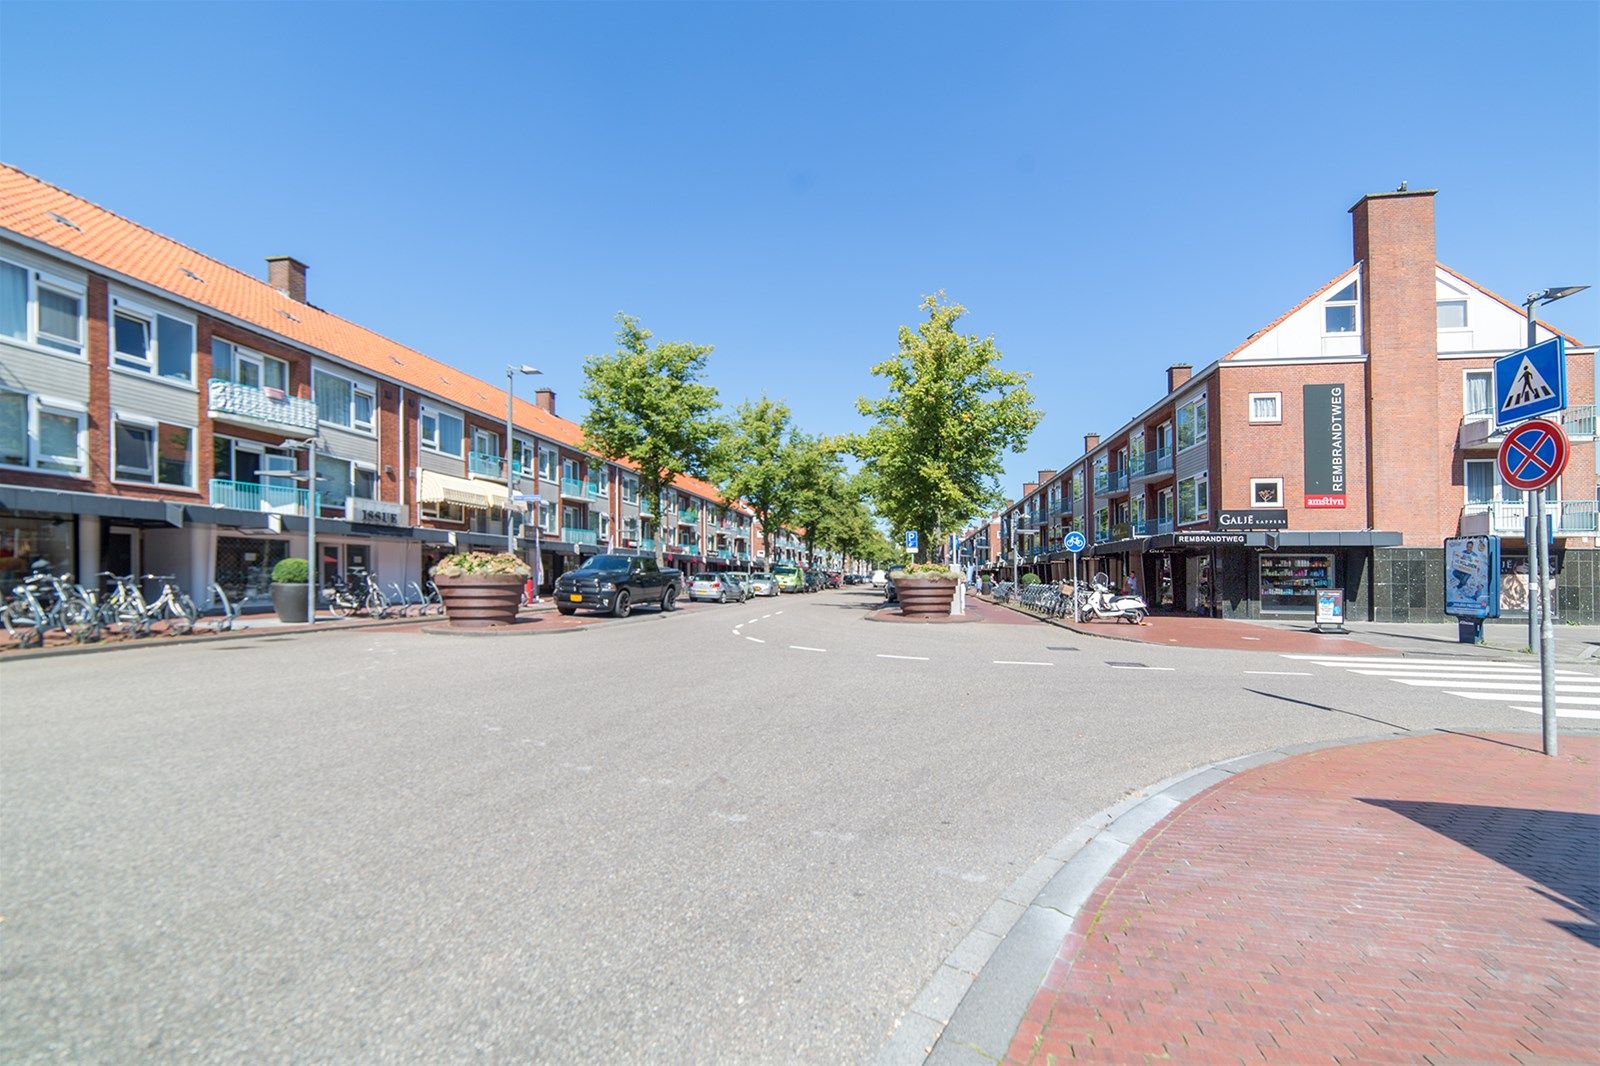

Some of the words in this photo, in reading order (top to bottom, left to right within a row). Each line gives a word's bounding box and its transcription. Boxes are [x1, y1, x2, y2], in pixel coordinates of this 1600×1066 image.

[1331, 387, 1342, 491] REMBRANDTWEG
[361, 509, 398, 524] ISSUE
[1178, 535, 1245, 543] REMBRANDTWEG
